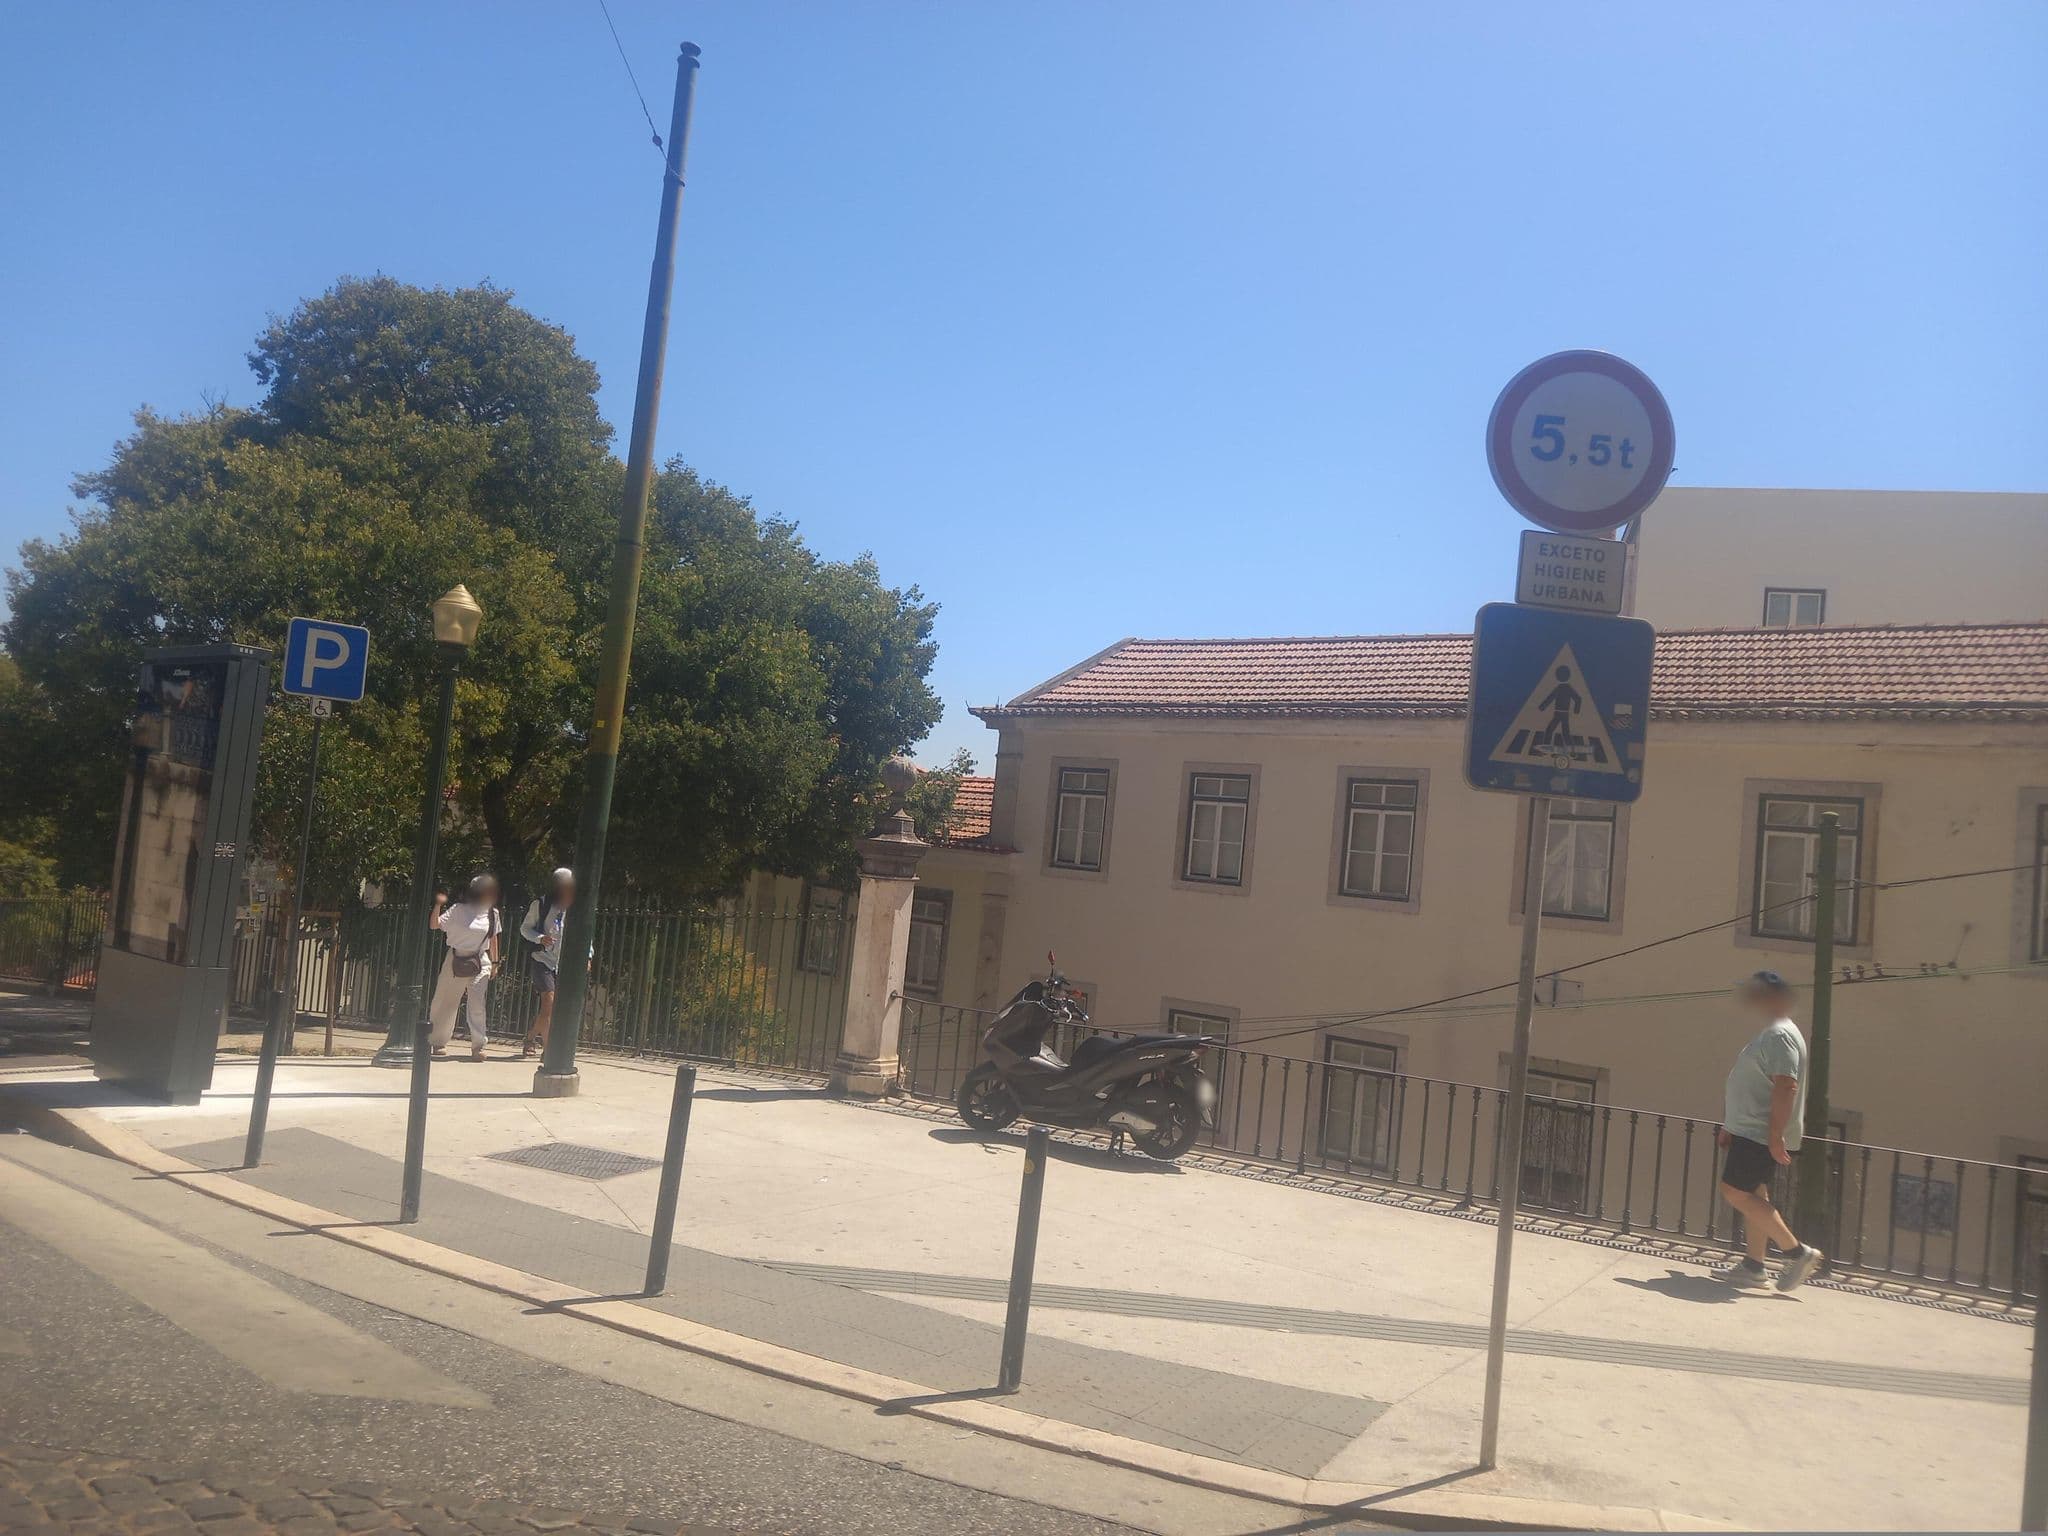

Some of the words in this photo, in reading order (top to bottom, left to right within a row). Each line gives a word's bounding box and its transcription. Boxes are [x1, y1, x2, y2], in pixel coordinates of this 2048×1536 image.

[1539, 543, 1605, 564] EXCETO
[1534, 562, 1607, 584] HIGIENE
[1532, 583, 1605, 603] URBANA
[301, 627, 350, 688] P
